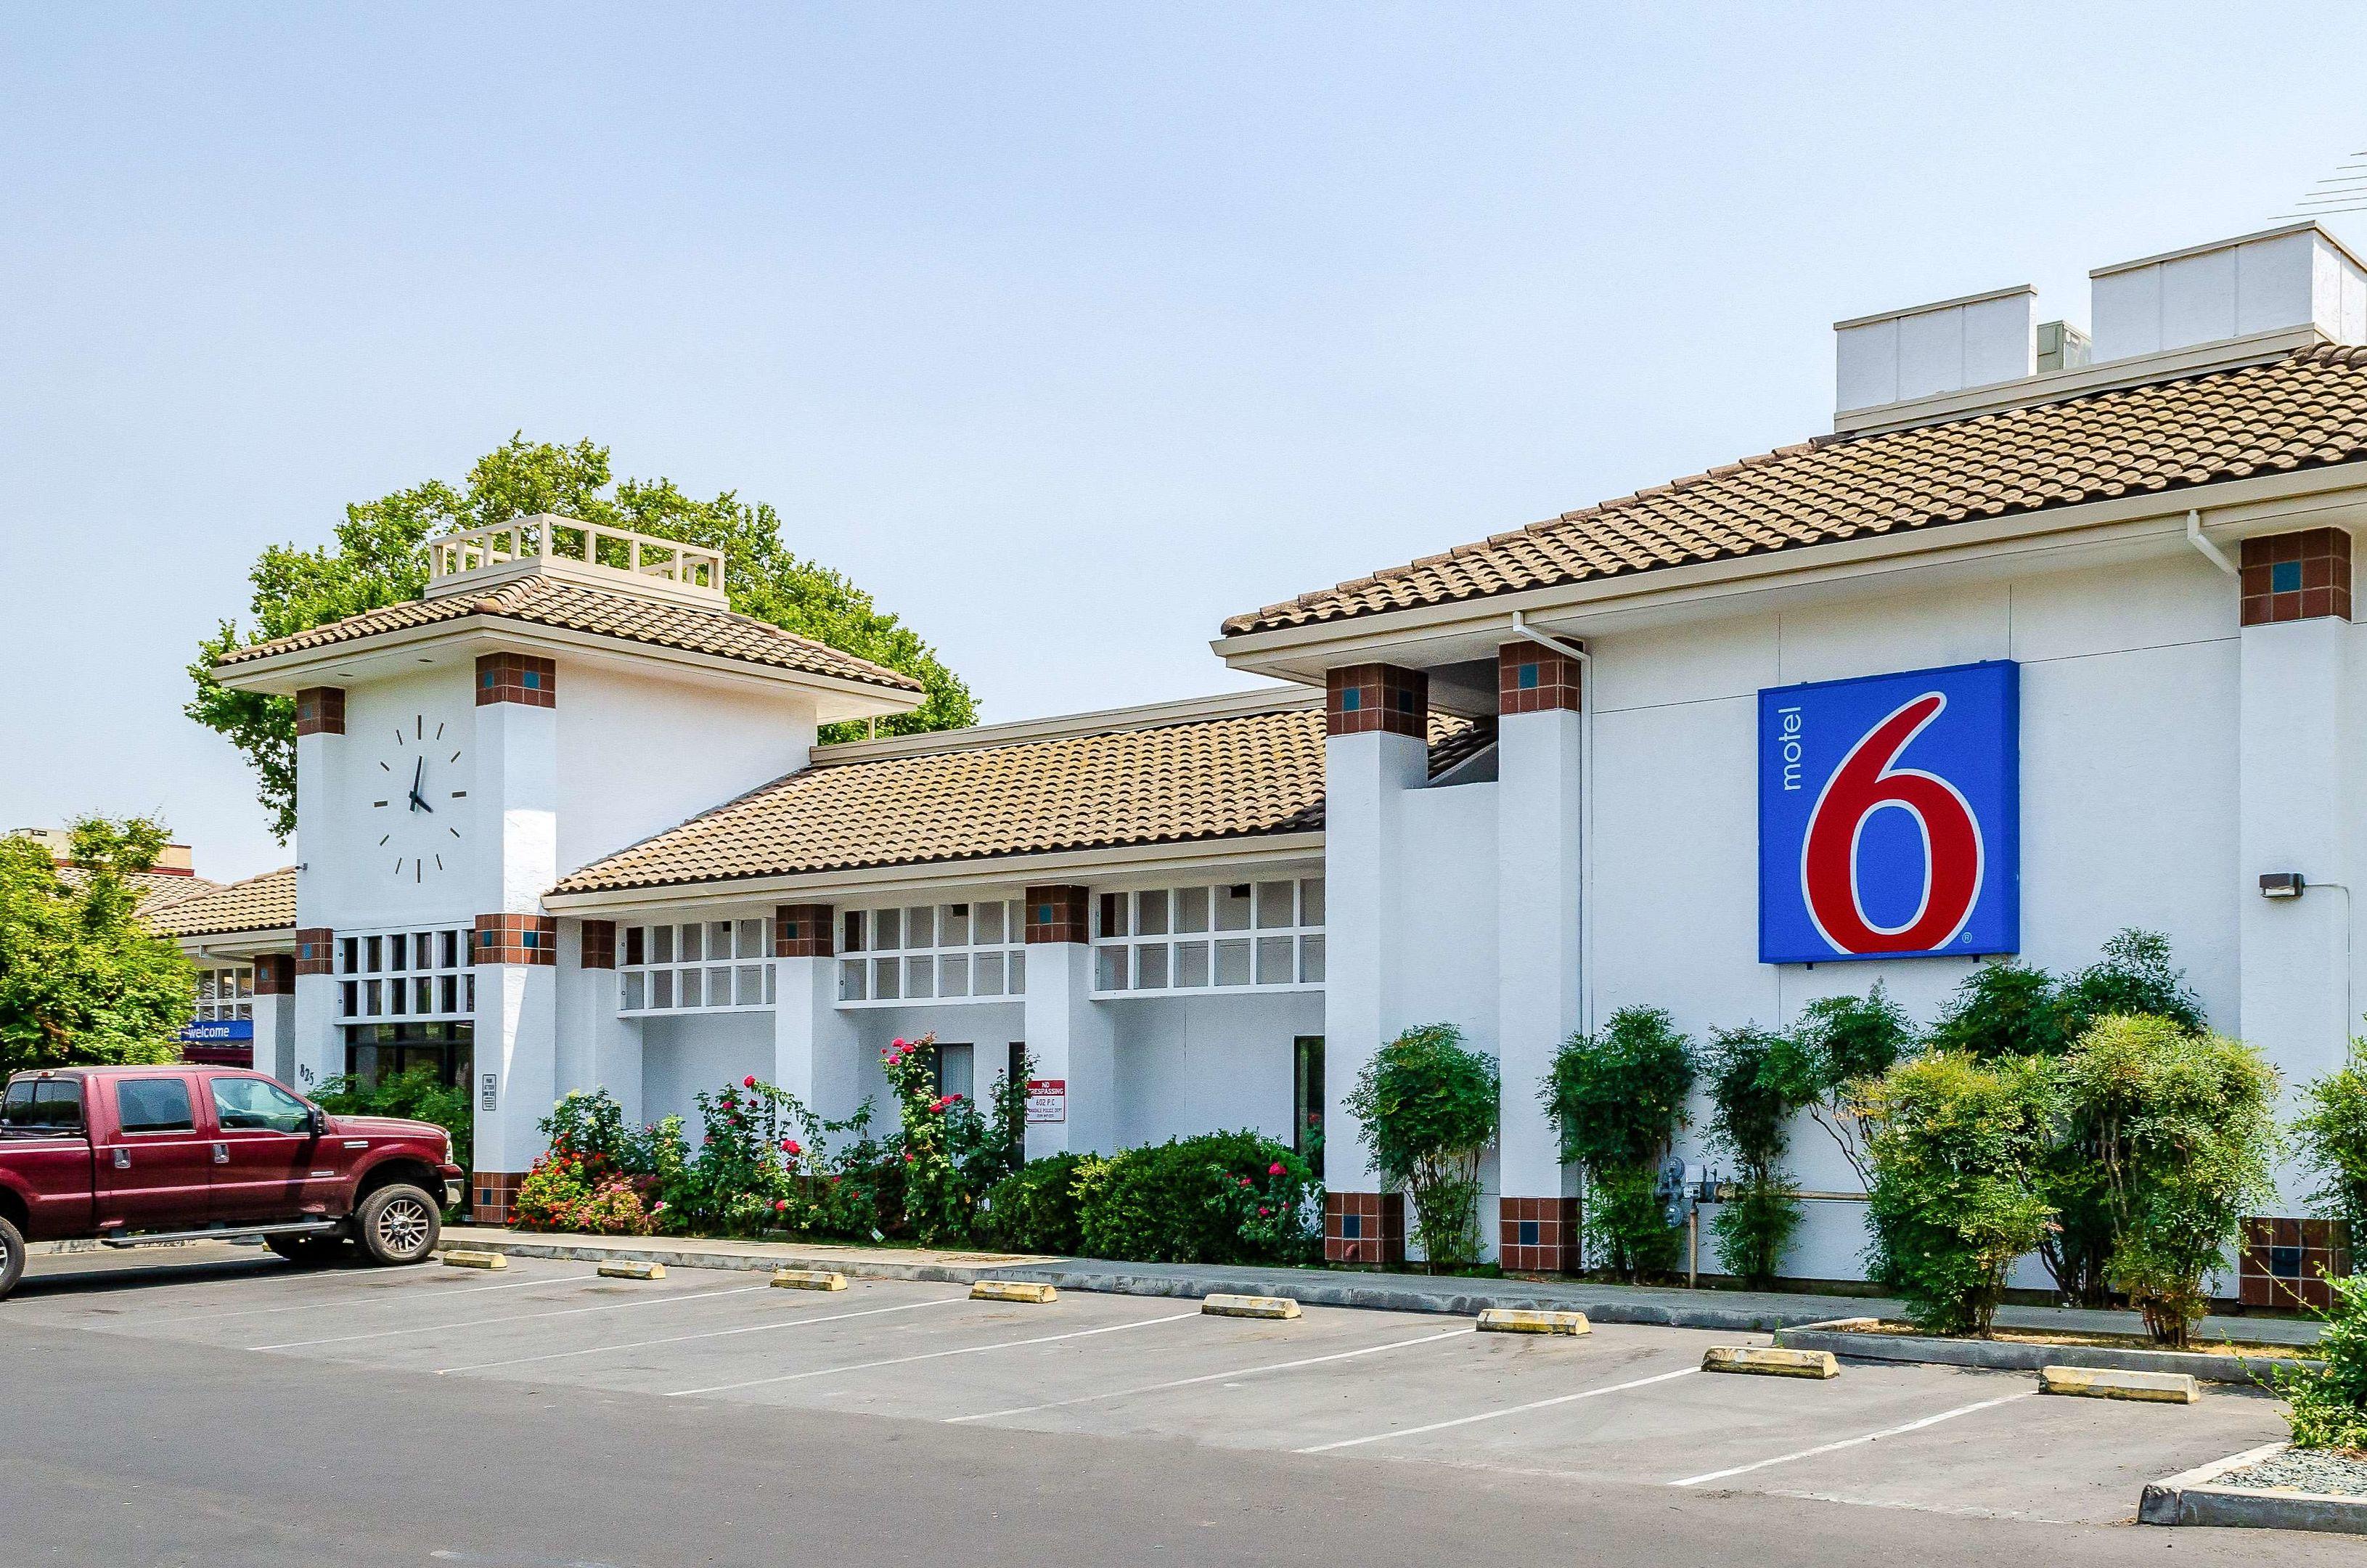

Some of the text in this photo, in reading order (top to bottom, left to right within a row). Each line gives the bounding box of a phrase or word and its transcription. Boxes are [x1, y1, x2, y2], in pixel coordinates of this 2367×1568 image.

[1778, 706, 1802, 791] motel
[1800, 690, 1985, 955] 6
[188, 1024, 230, 1039] welcome
[300, 1063, 314, 1086] 825
